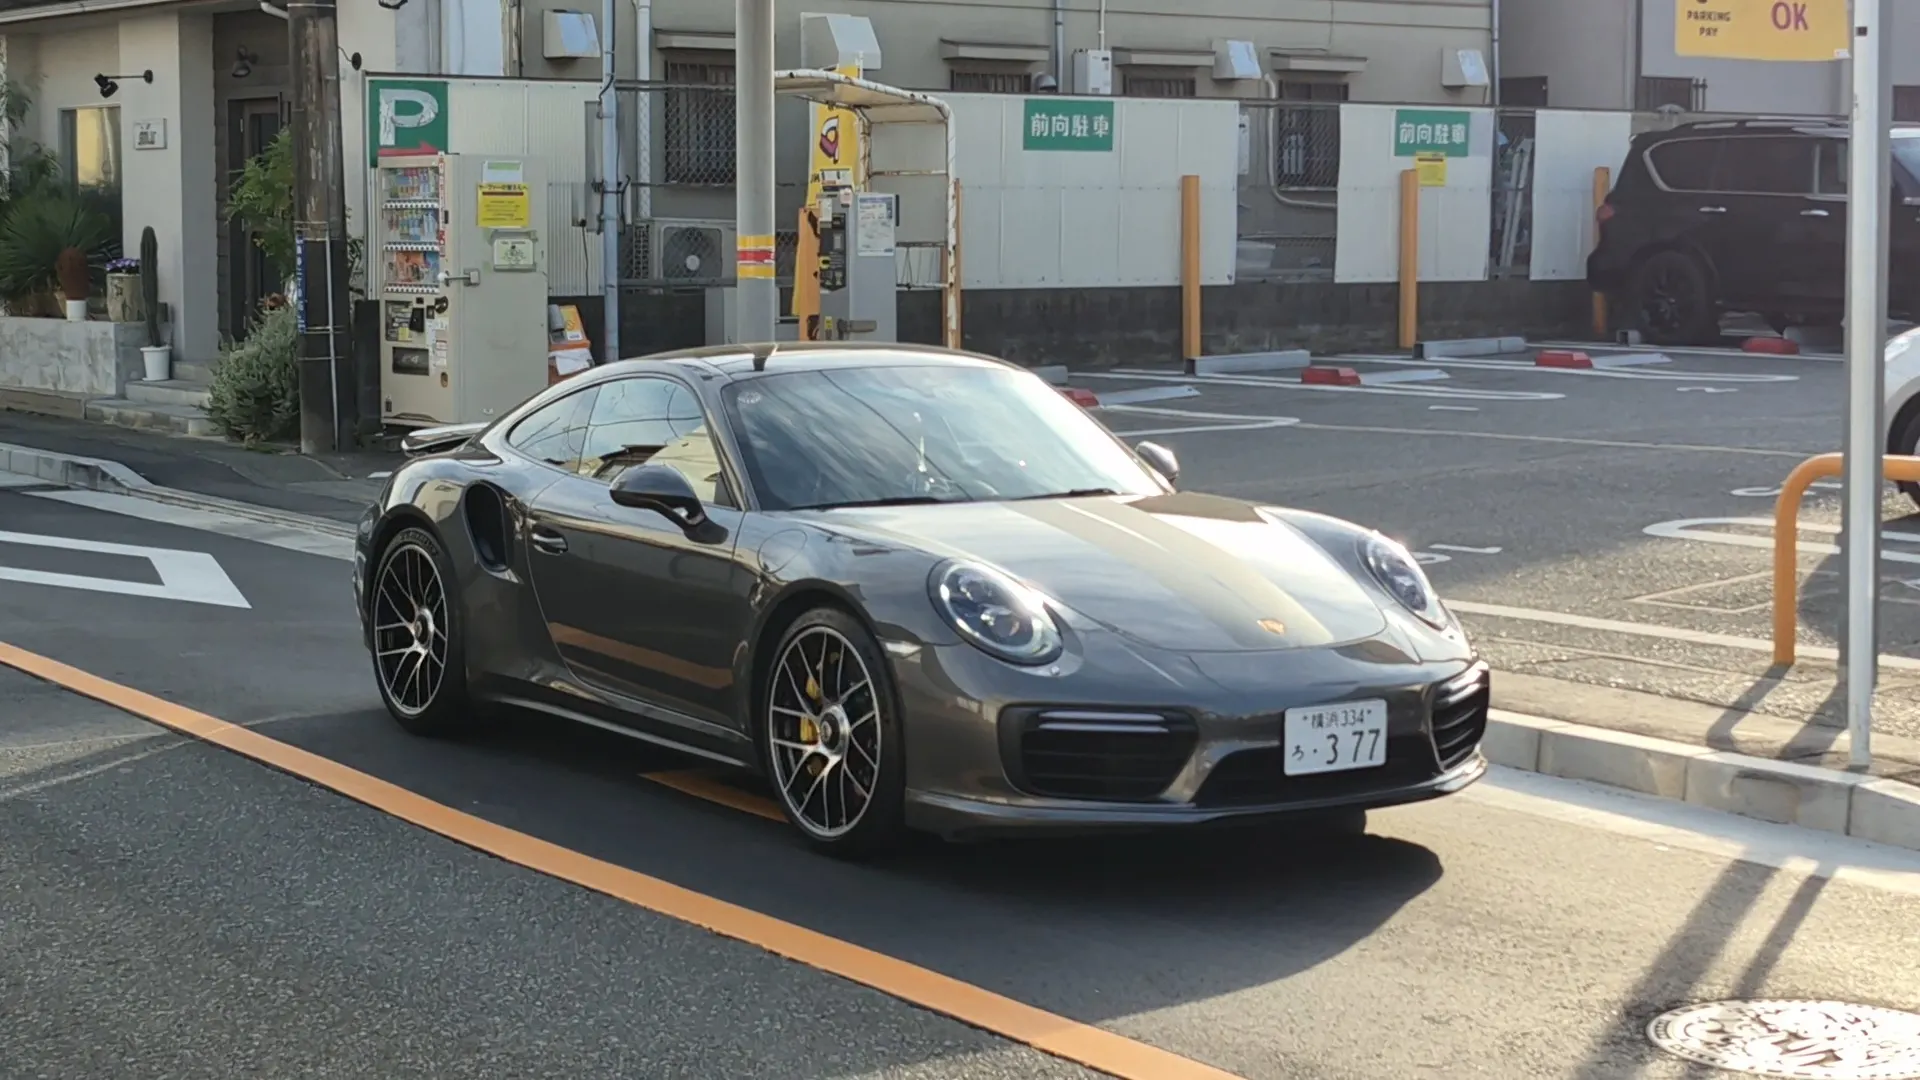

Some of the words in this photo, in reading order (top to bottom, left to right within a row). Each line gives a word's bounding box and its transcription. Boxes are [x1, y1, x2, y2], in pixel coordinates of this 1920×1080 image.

[1687, 10, 1731, 22] PARKING
[1771, 1, 1808, 31] OK
[1699, 26, 1718, 37] PAY
[379, 88, 438, 145] P
[1031, 112, 1109, 138] 前向駐車
[1400, 122, 1465, 144] 前向駐車
